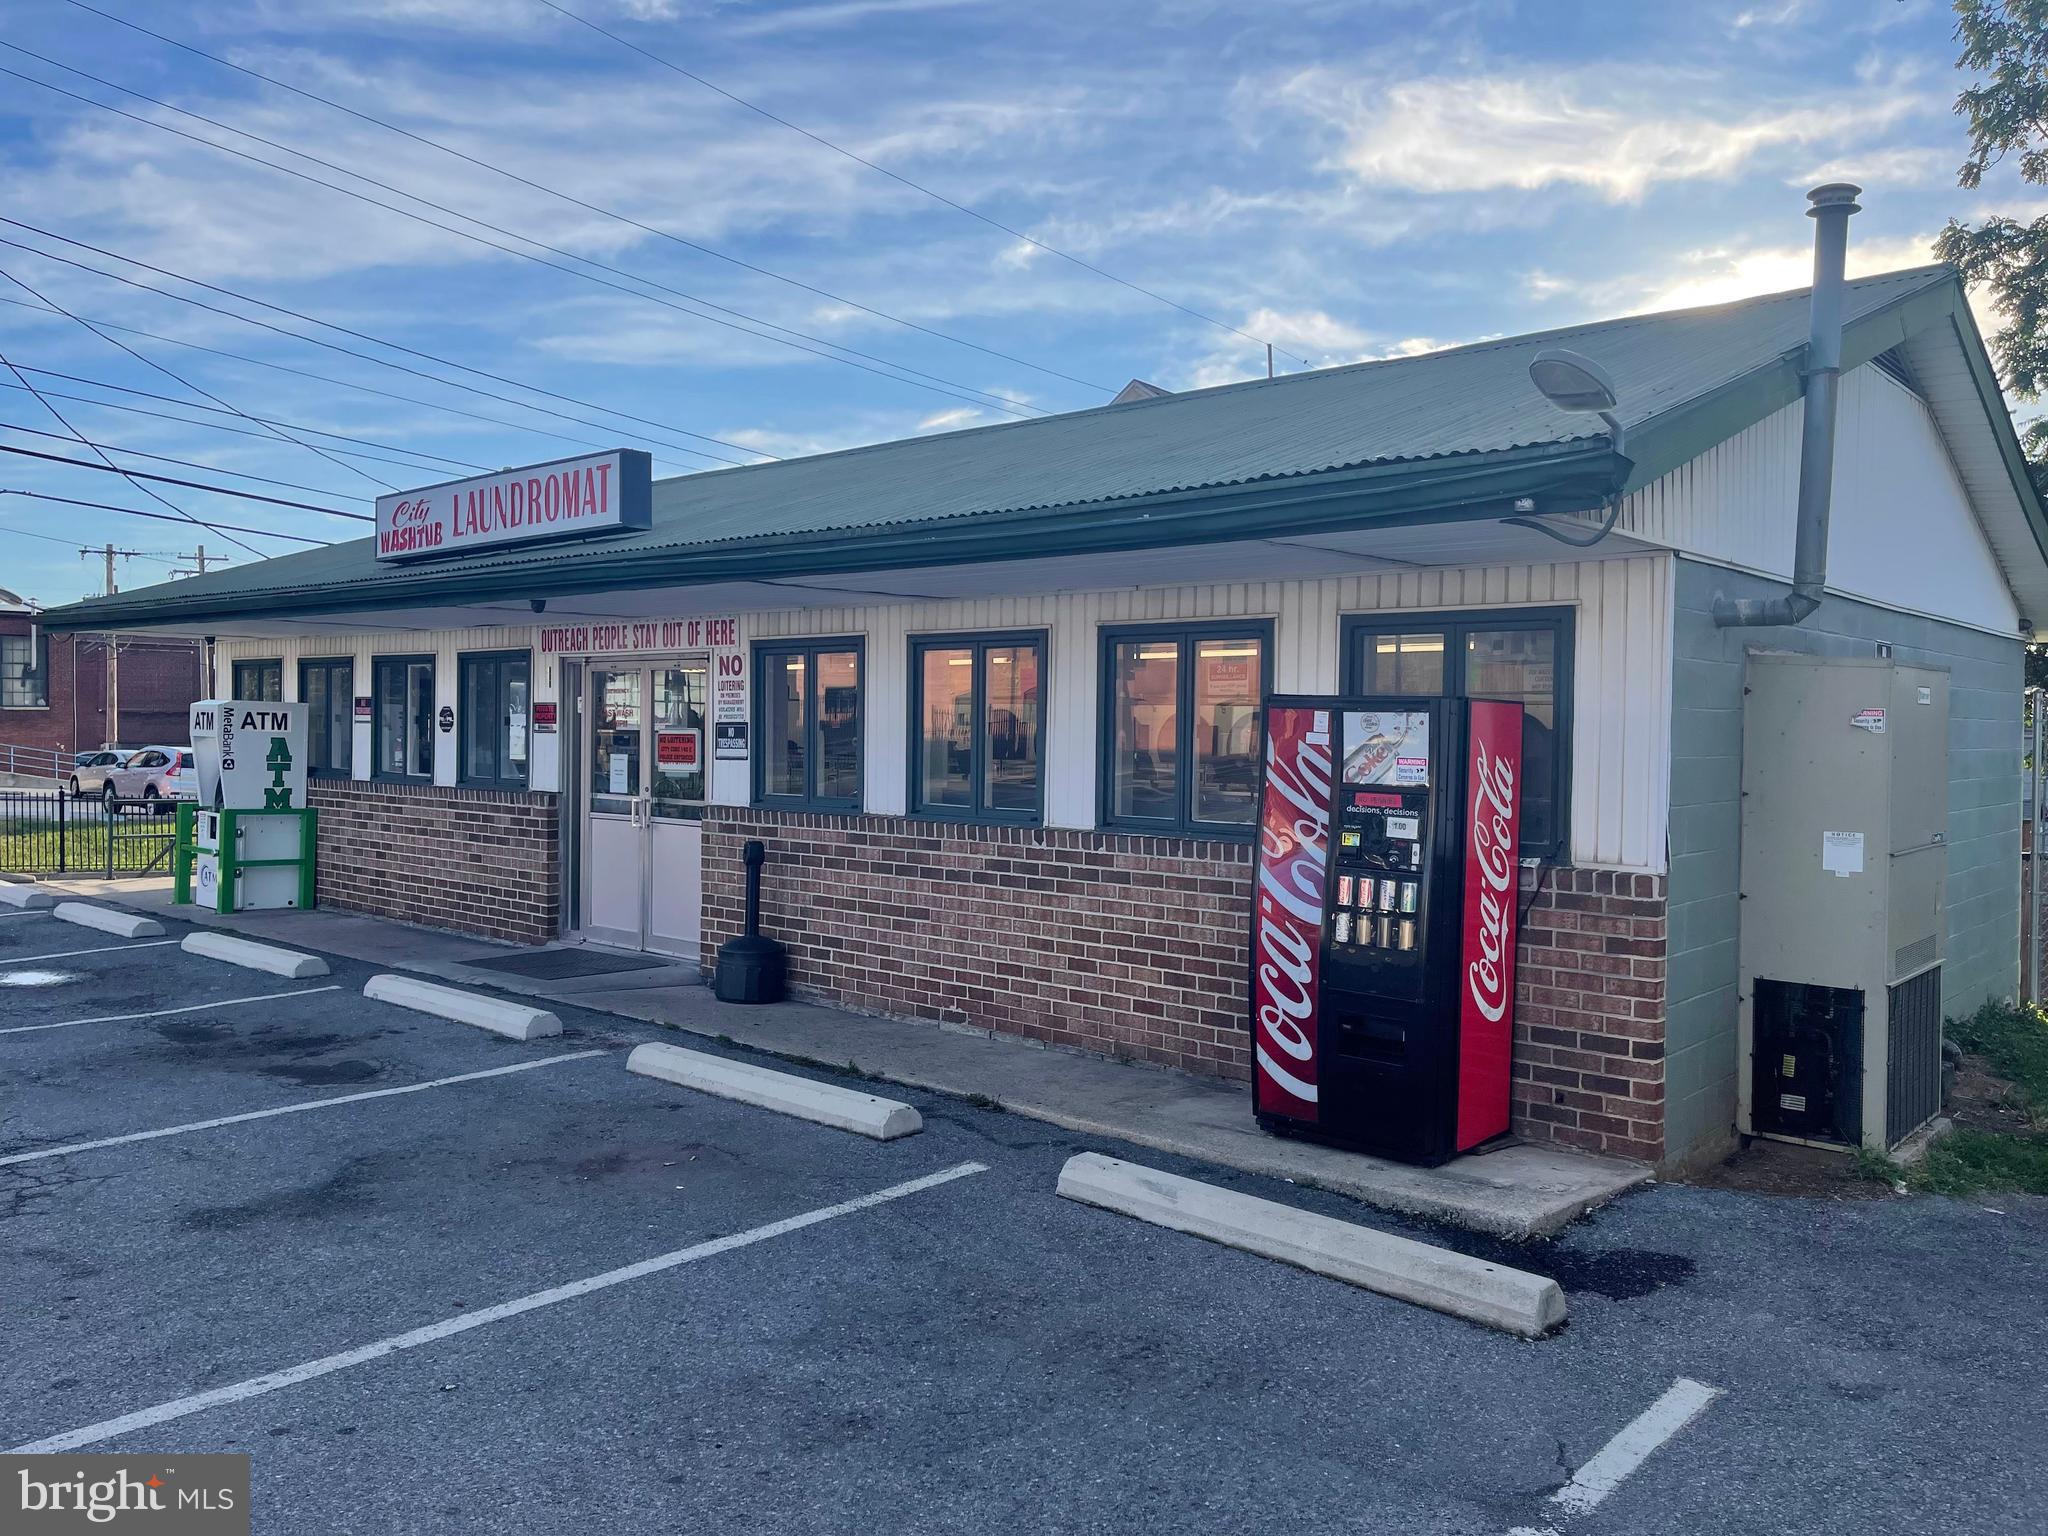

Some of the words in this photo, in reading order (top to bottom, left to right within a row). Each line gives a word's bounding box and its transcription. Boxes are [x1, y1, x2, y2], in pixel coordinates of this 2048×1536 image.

[452, 463, 611, 537] LAUNDROMAT
[392, 499, 431, 528] City
[380, 522, 442, 553] WASHTUB
[541, 627, 588, 653] OUTREACH
[593, 624, 628, 650] PEOPLE
[633, 623, 658, 649] STAY
[662, 622, 683, 647] OUT
[688, 621, 701, 647] OF
[706, 619, 736, 646] HERE
[719, 655, 743, 676] NO
[717, 680, 745, 691] LOITERING
[194, 712, 214, 731] ATM
[240, 711, 288, 730] ATM
[223, 707, 234, 758] MetaBank
[727, 727, 735, 738] NO
[1399, 758, 1426, 766] WARNING
[1346, 805, 1382, 816] decisions,
[1383, 807, 1419, 817] decisions
[1469, 737, 1515, 1022] Coca-Cola
